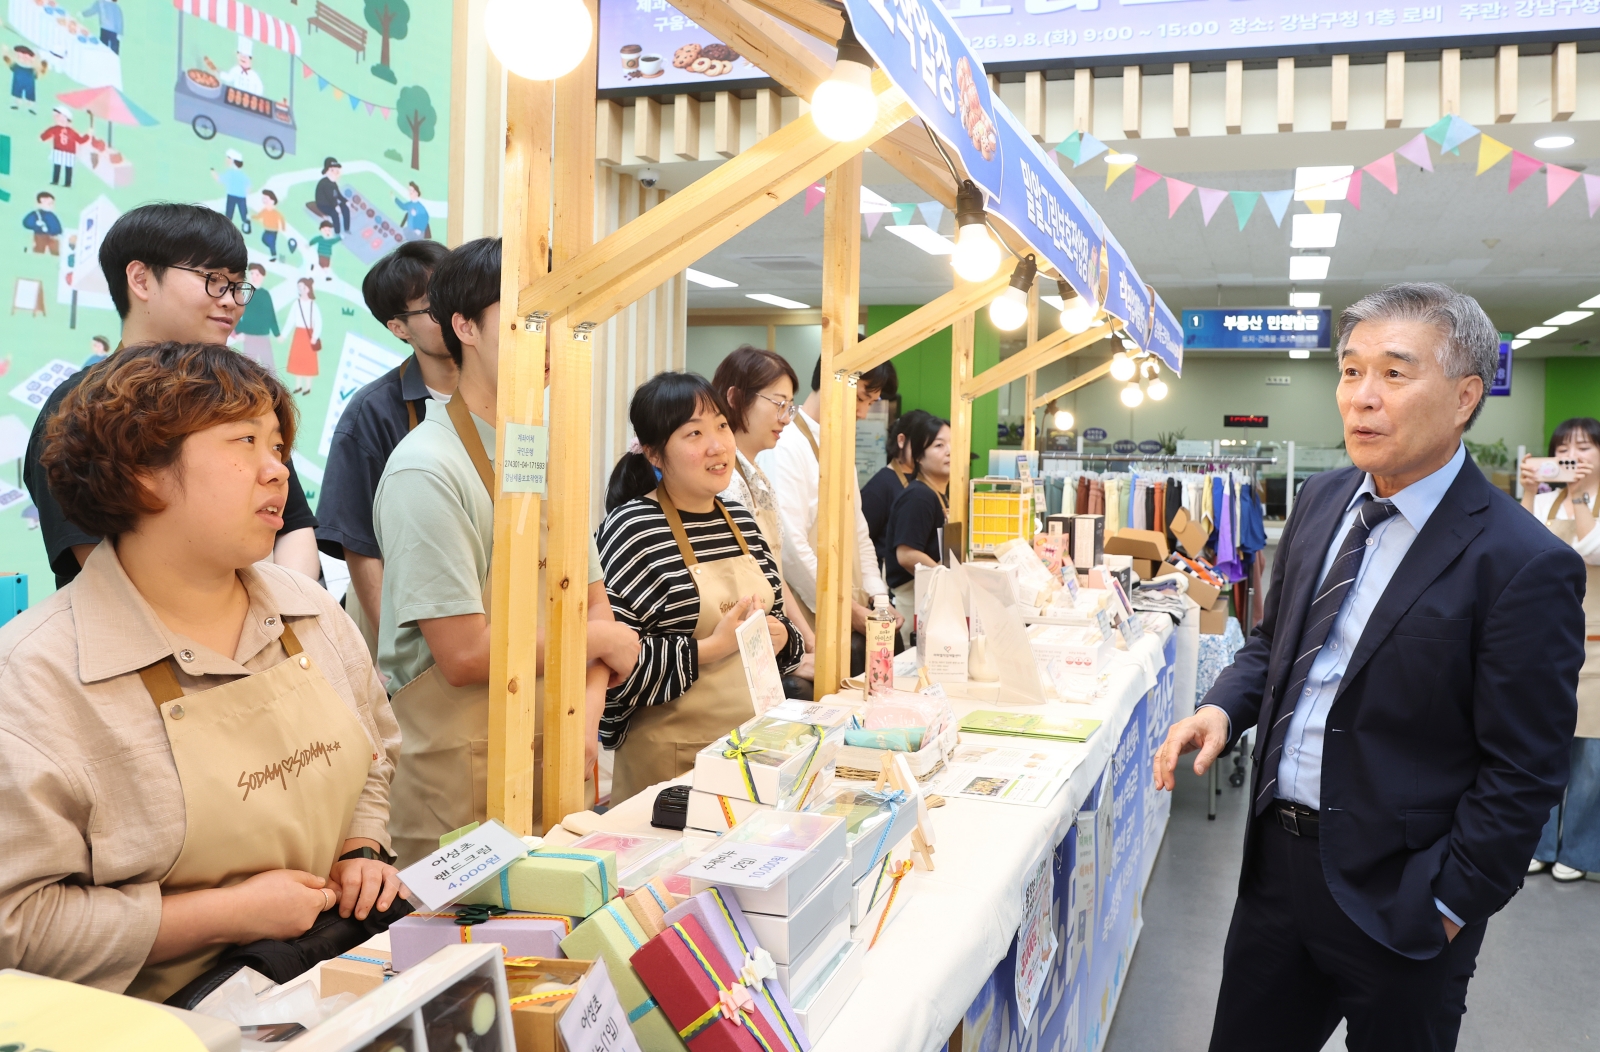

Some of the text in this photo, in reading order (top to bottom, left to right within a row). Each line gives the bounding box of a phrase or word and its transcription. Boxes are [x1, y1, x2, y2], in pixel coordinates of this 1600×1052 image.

[1083, 26, 1133, 42] 9:00
[1157, 21, 1220, 38] 15:00
[1228, 16, 1275, 35] 장소:
[1280, 10, 1360, 32] 강남구청
[1364, 8, 1398, 27] 1층
[1402, 5, 1443, 24] 로비
[1459, 1, 1509, 22] 주관:
[1020, 157, 1089, 284] 밀알그린보호작업장
[1192, 315, 1199, 327] 1
[1223, 315, 1263, 331] 부동산
[237, 741, 331, 801] SODAM SODAM
[431, 842, 475, 867] 어성초
[581, 994, 603, 1029] 어성초
